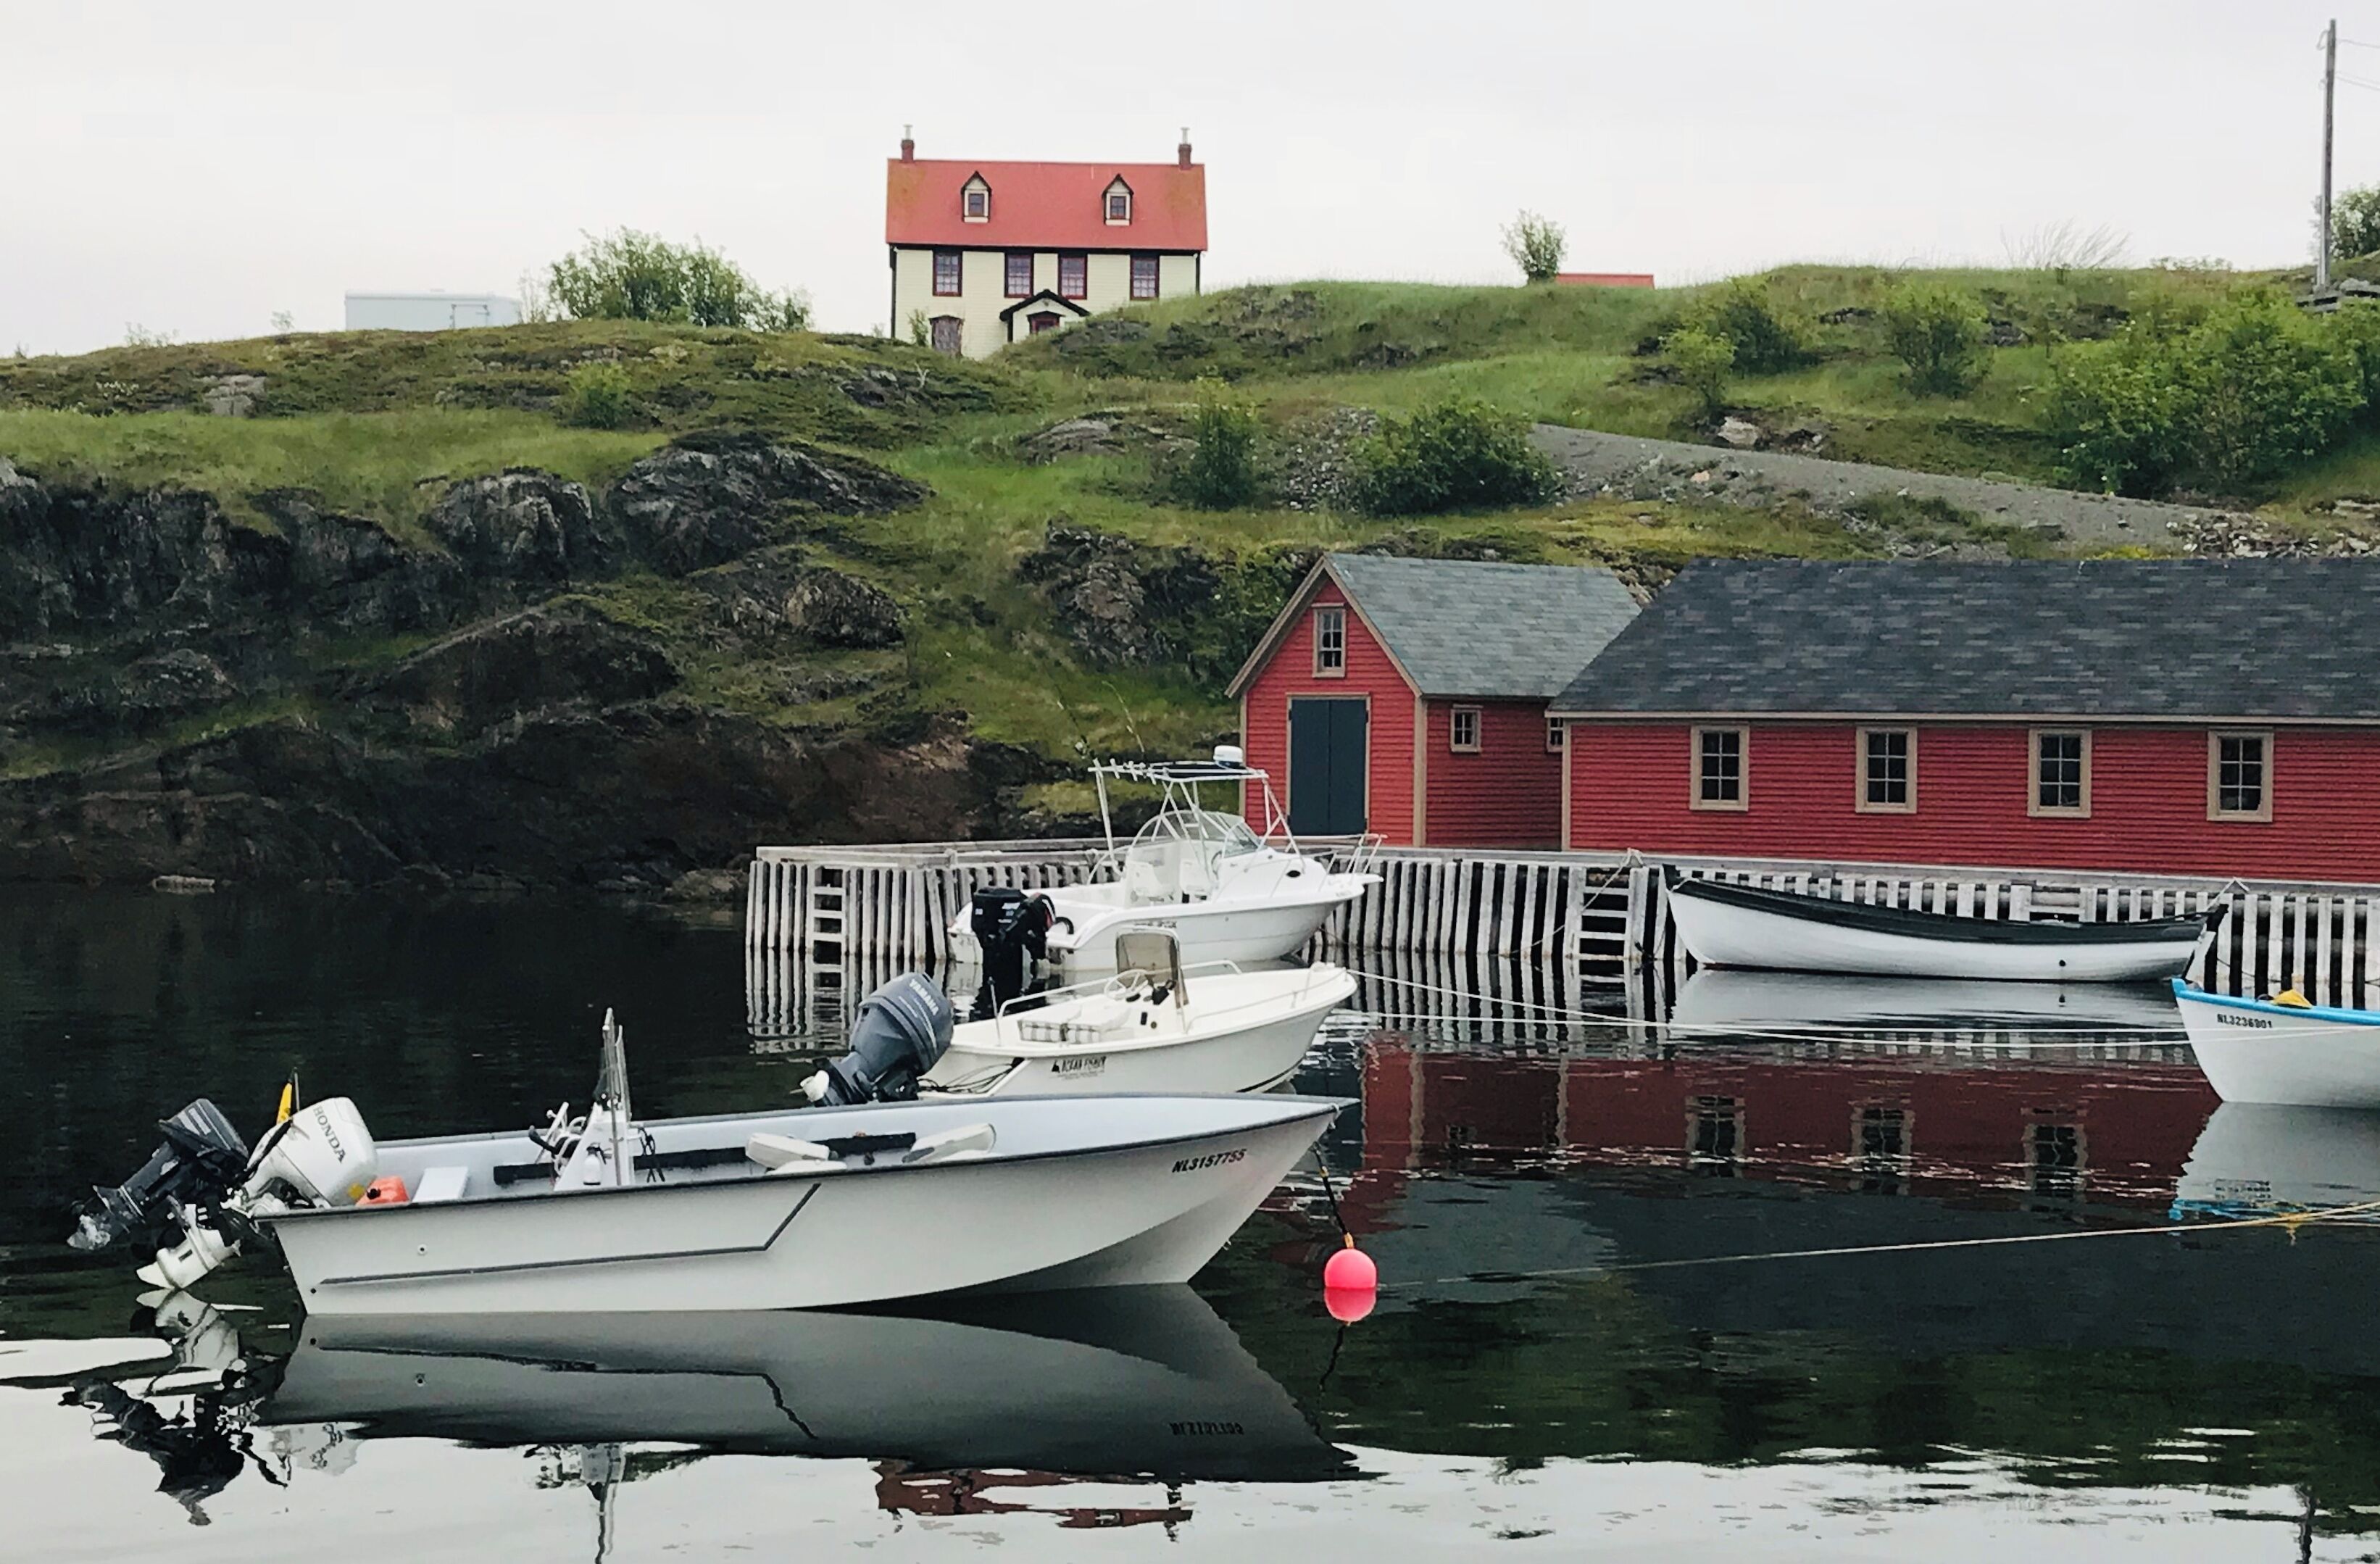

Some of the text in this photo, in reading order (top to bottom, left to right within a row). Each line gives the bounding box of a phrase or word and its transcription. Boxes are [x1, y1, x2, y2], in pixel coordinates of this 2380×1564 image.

[910, 978, 939, 1016] YAMAHA
[312, 1105, 346, 1164] HONDA
[1172, 1148, 1247, 1173] NL3157755
